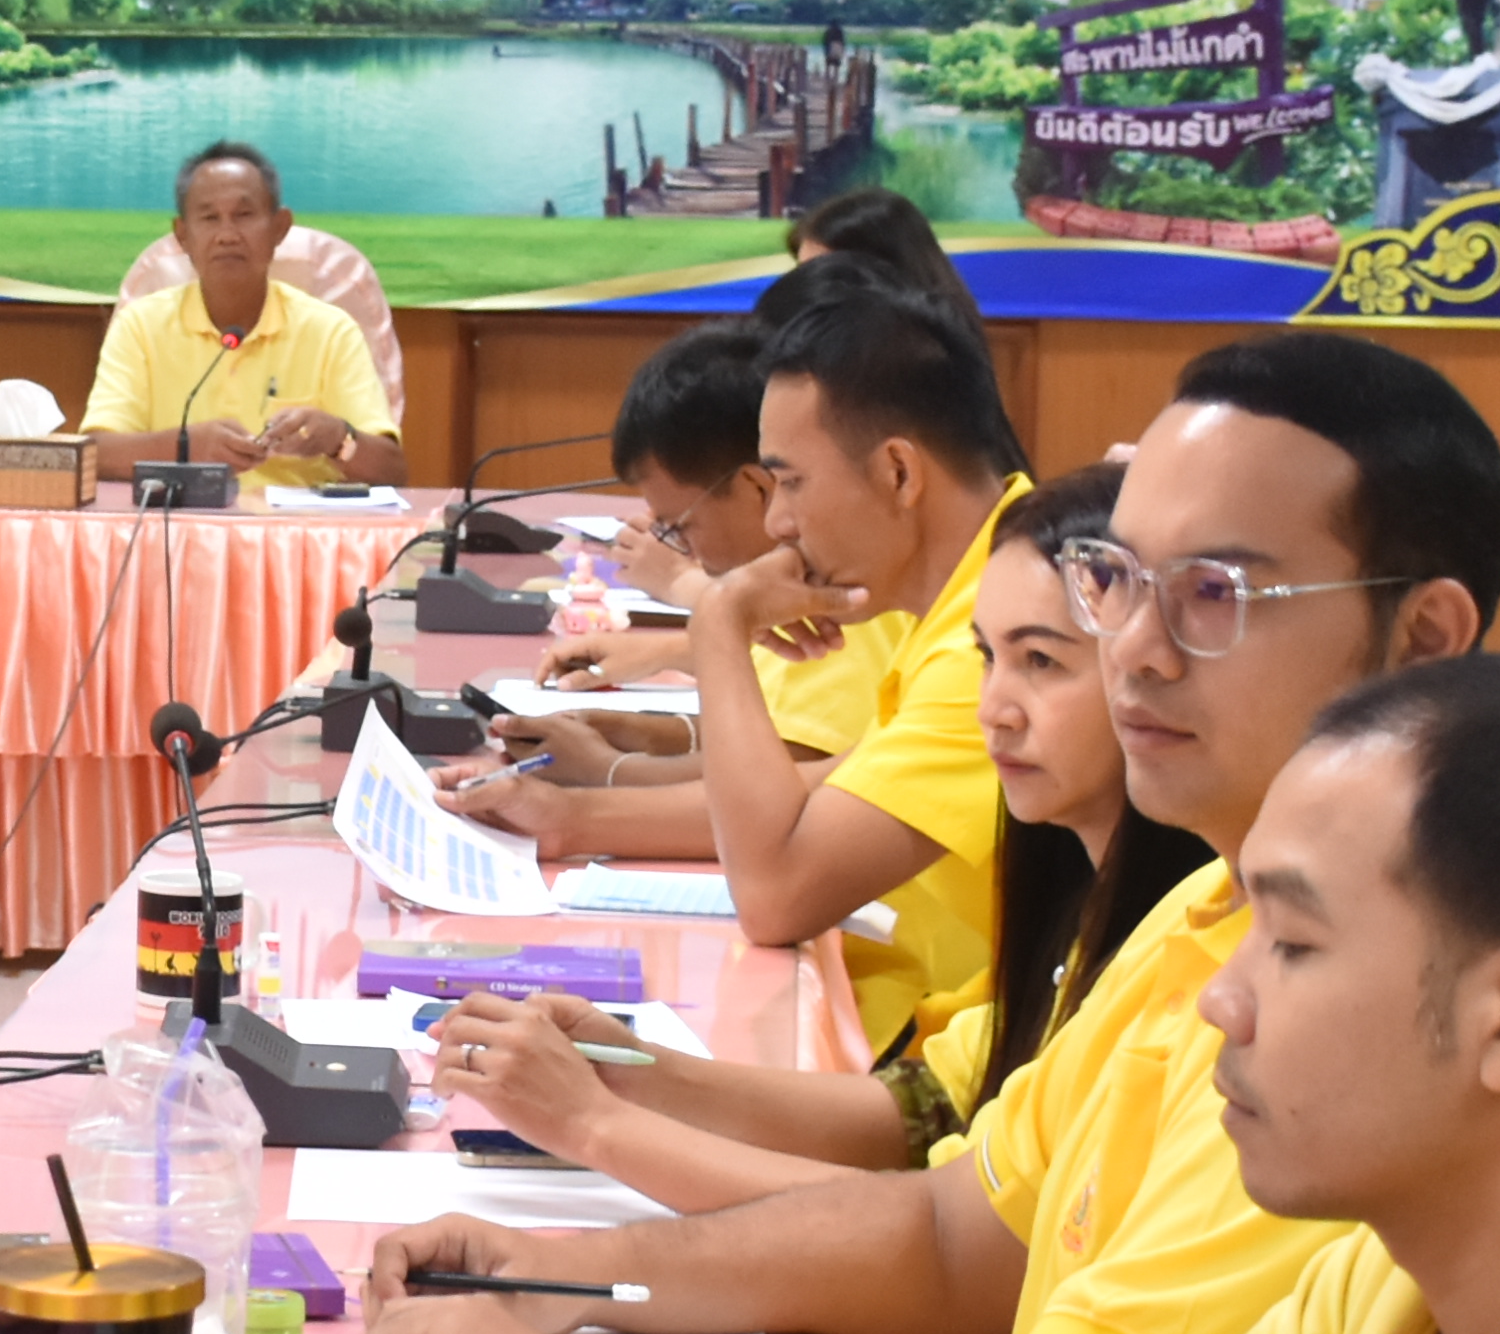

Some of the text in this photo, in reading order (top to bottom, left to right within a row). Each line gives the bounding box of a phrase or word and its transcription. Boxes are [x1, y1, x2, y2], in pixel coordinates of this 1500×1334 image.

[1034, 111, 1231, 148] ยินดีต้อนรับ
